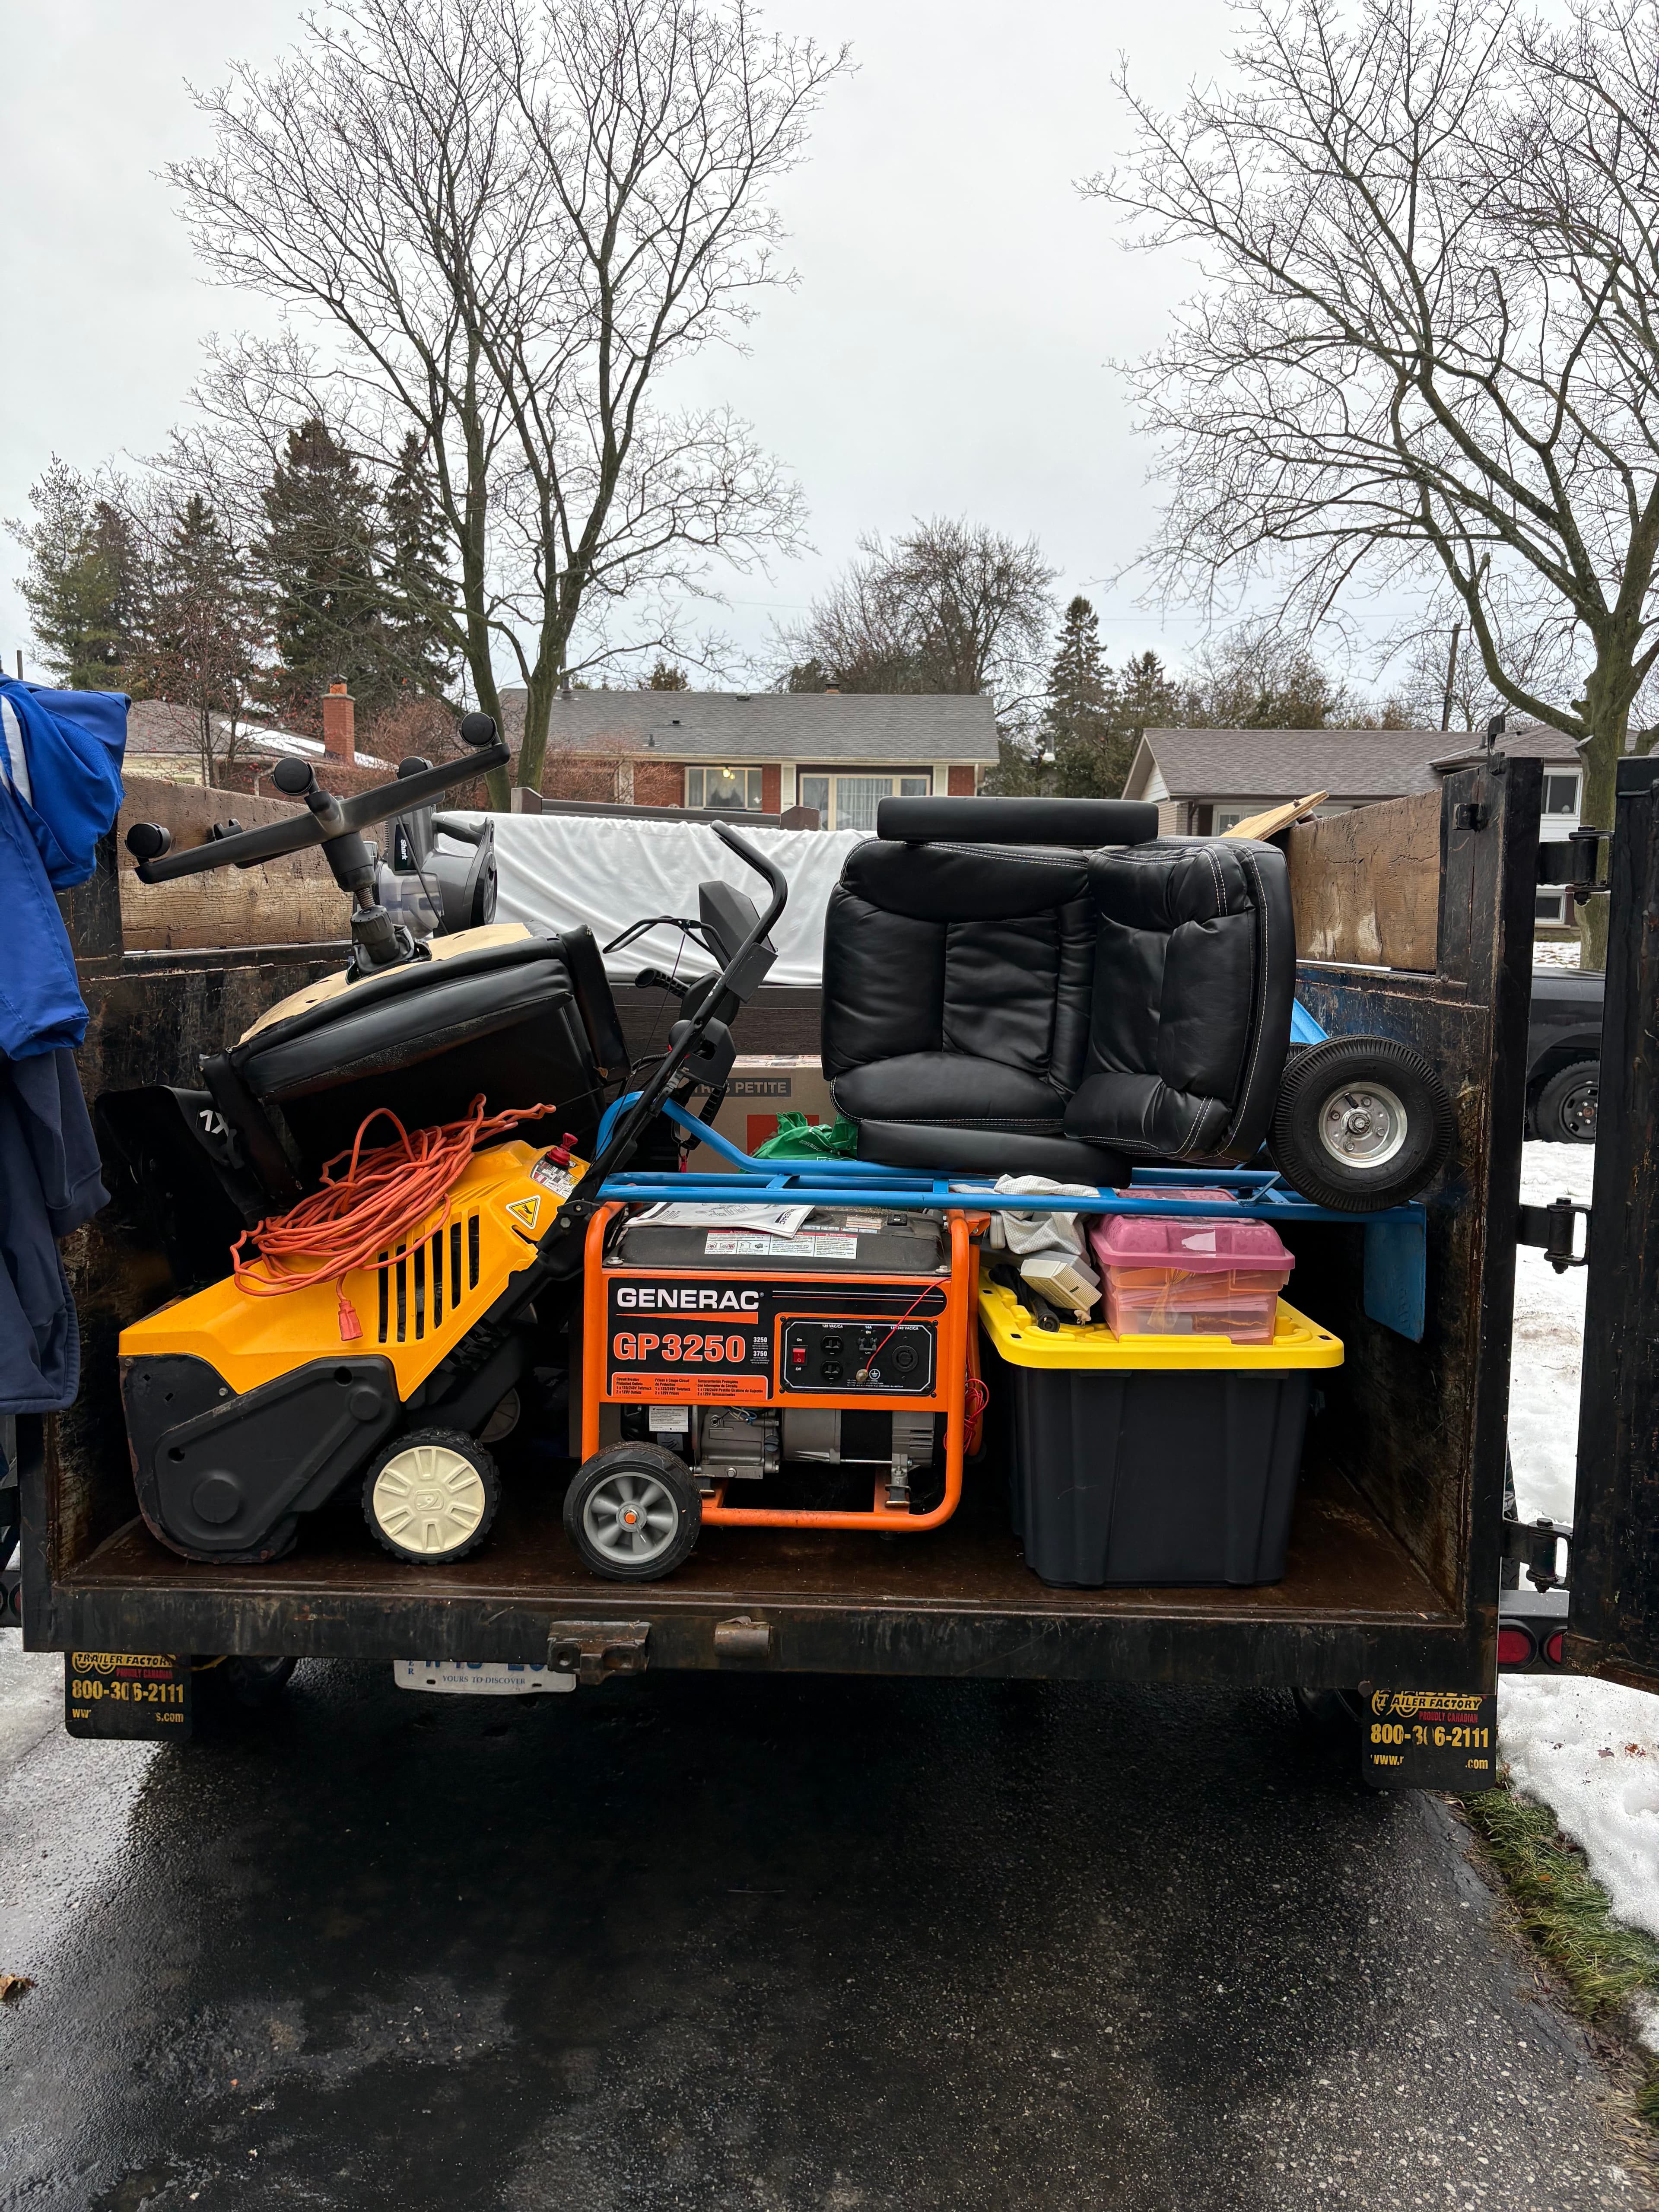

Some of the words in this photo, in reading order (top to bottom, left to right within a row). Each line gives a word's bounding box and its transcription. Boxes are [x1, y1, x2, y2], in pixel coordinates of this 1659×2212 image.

[735, 1082, 787, 1093] PETITE
[617, 1288, 759, 1309] GENERAC
[613, 1332, 746, 1363] GP3250
[77, 1654, 123, 1664] TRAILER
[442, 1675, 469, 1683] YOURS
[485, 1676, 526, 1685] DISCOVER
[72, 1679, 184, 1703] 800-306-2111
[1377, 1697, 1427, 1707] TAILER
[1429, 1699, 1481, 1709] FACTORY
[1418, 1711, 1446, 1722] PROUDLY
[1447, 1713, 1478, 1723] CANADIAN
